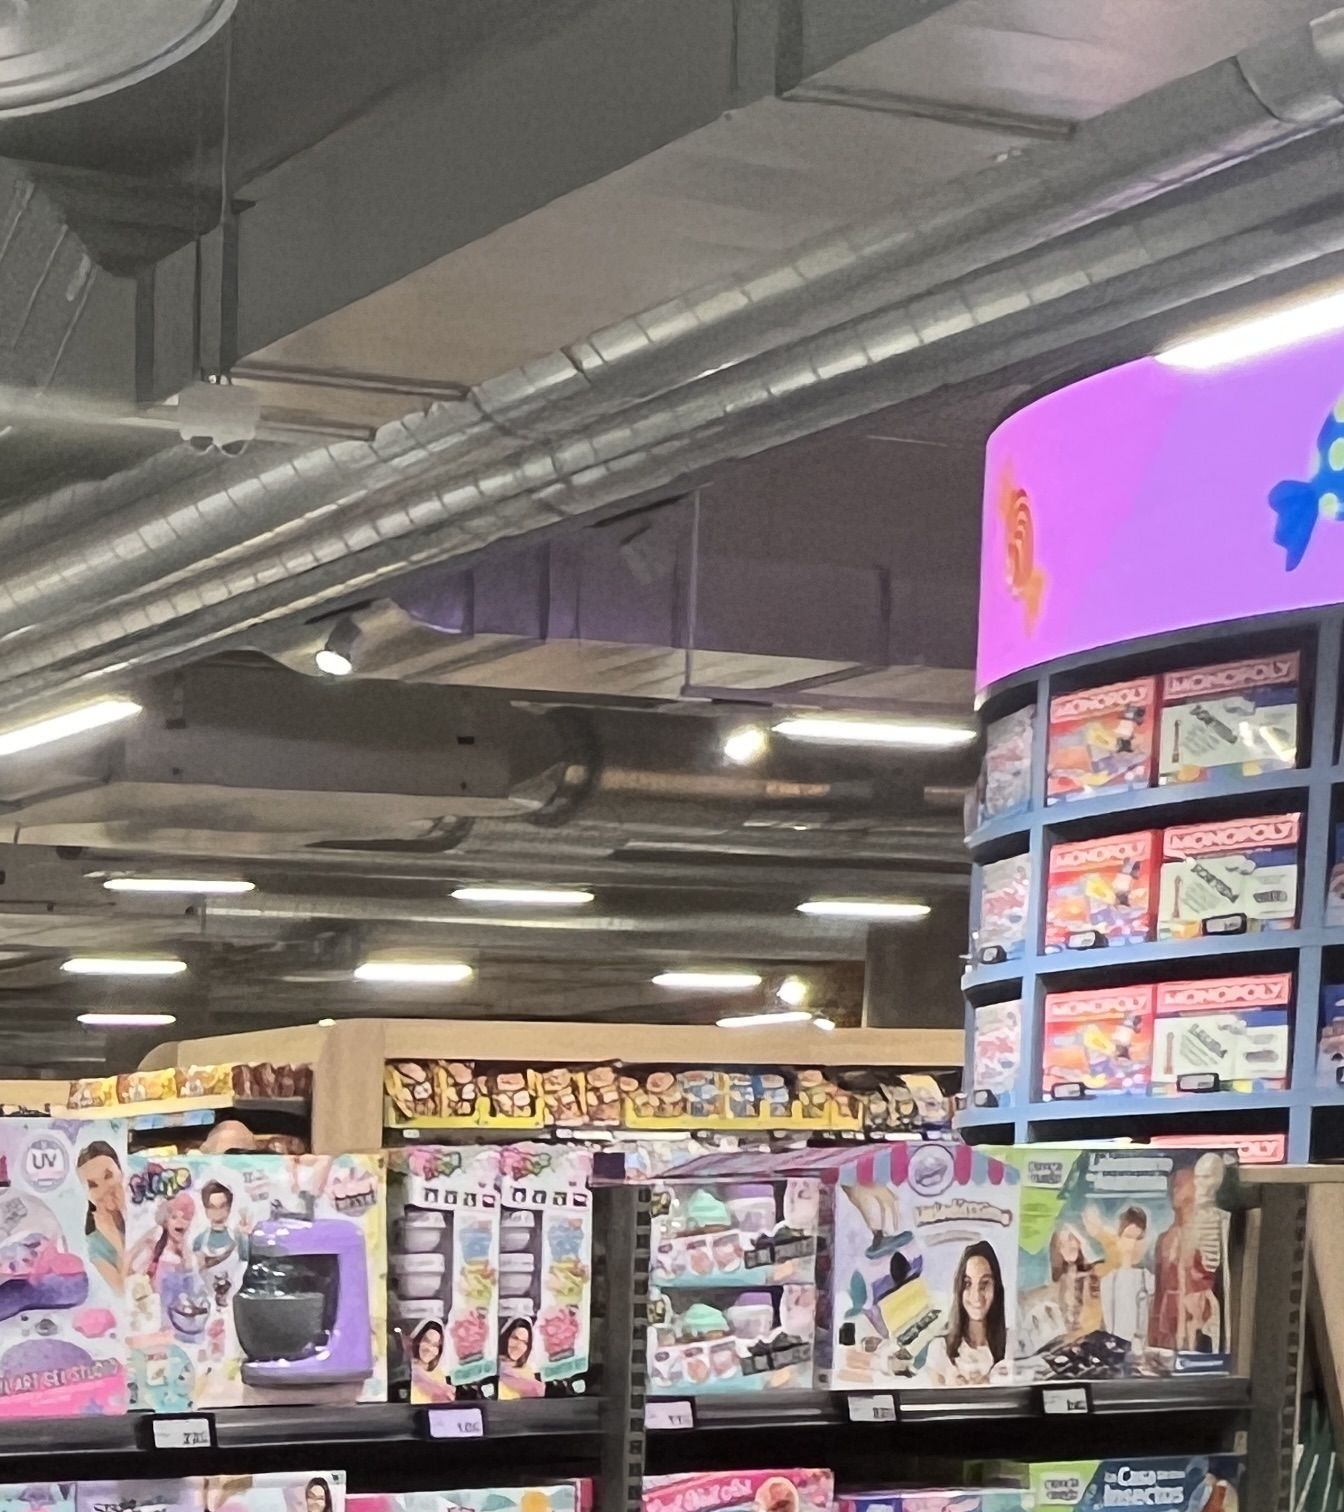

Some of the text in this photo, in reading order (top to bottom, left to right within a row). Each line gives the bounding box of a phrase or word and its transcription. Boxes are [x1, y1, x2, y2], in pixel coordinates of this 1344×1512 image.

[1169, 660, 1291, 691] MONOPOLY
[1055, 686, 1149, 717] MONOPOLY
[1170, 821, 1294, 850] MONOPOLY
[1055, 840, 1148, 867] MONOPOLY
[1051, 994, 1148, 1016] MONOPOLY
[1164, 981, 1284, 1005] MONOPOLY
[32, 1152, 57, 1170] UV
